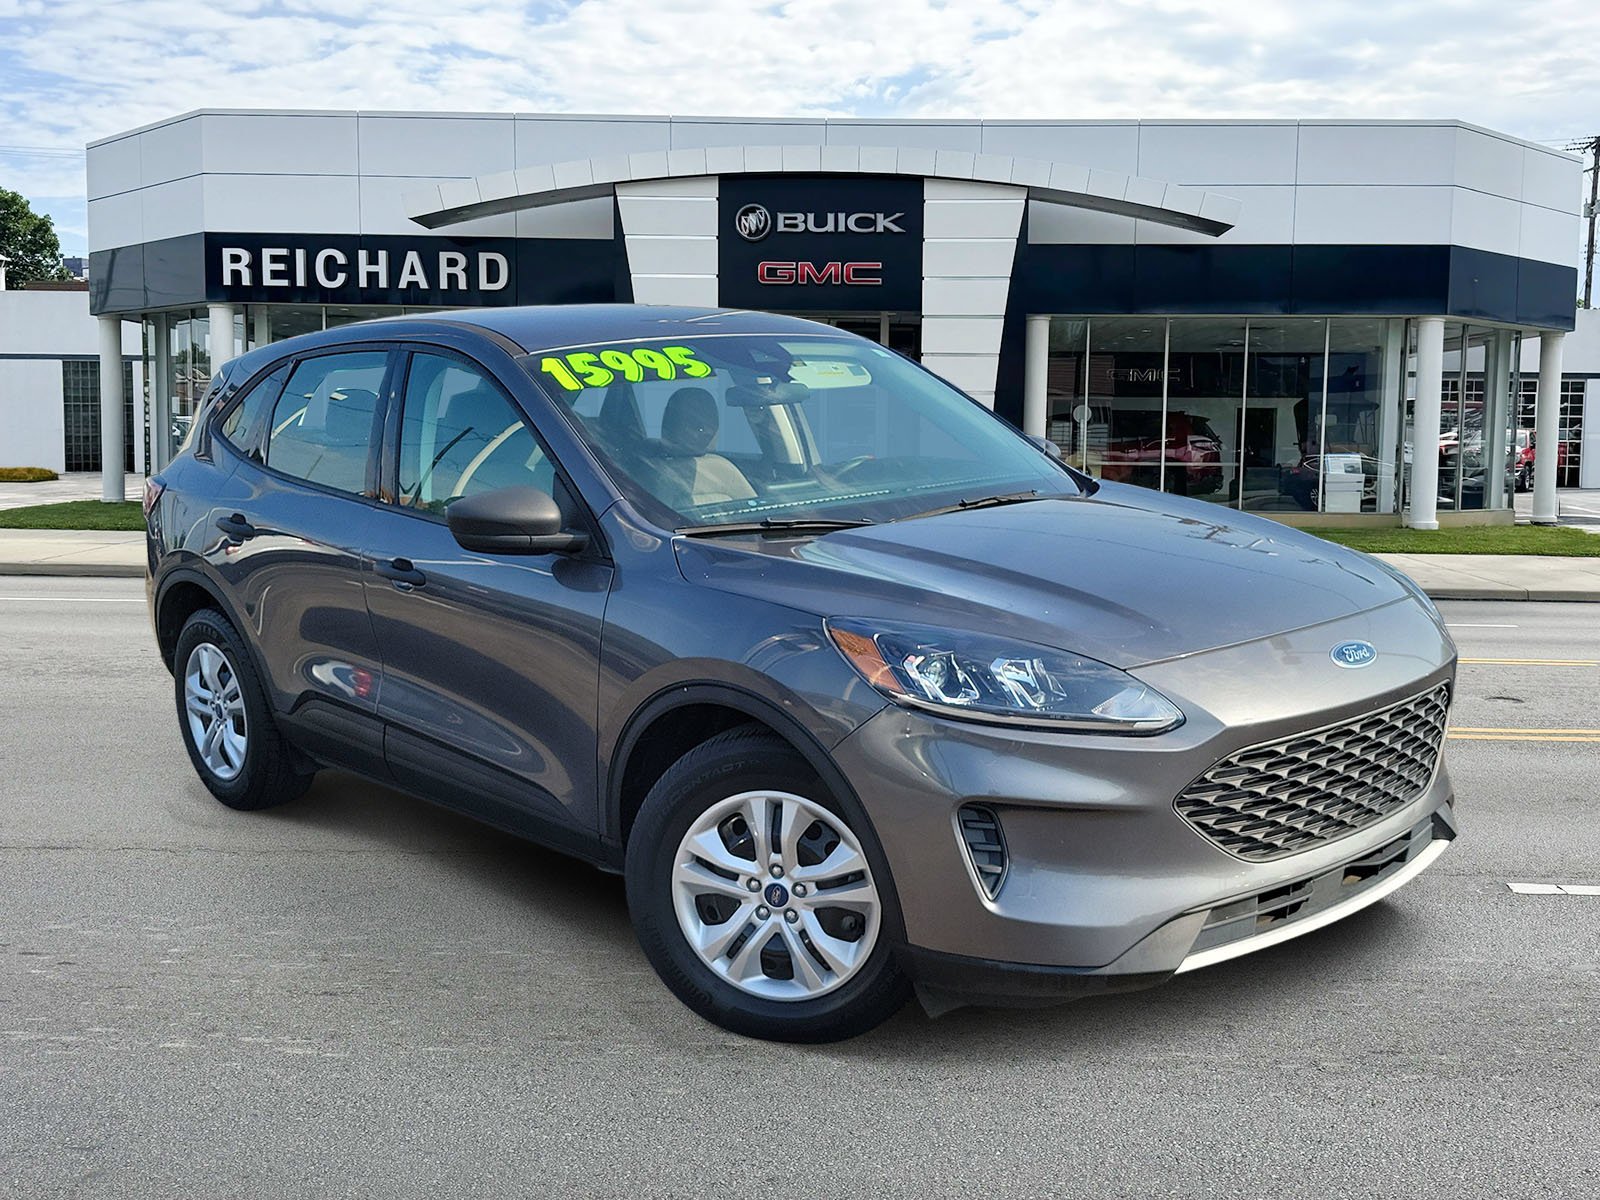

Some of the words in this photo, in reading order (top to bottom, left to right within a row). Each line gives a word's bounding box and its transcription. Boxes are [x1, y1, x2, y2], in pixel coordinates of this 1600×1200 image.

[776, 212, 907, 233] BUICK
[221, 247, 510, 291] REICHARD
[757, 261, 883, 286] GMC
[541, 345, 712, 391] 15995
[1342, 644, 1370, 662] Ford
